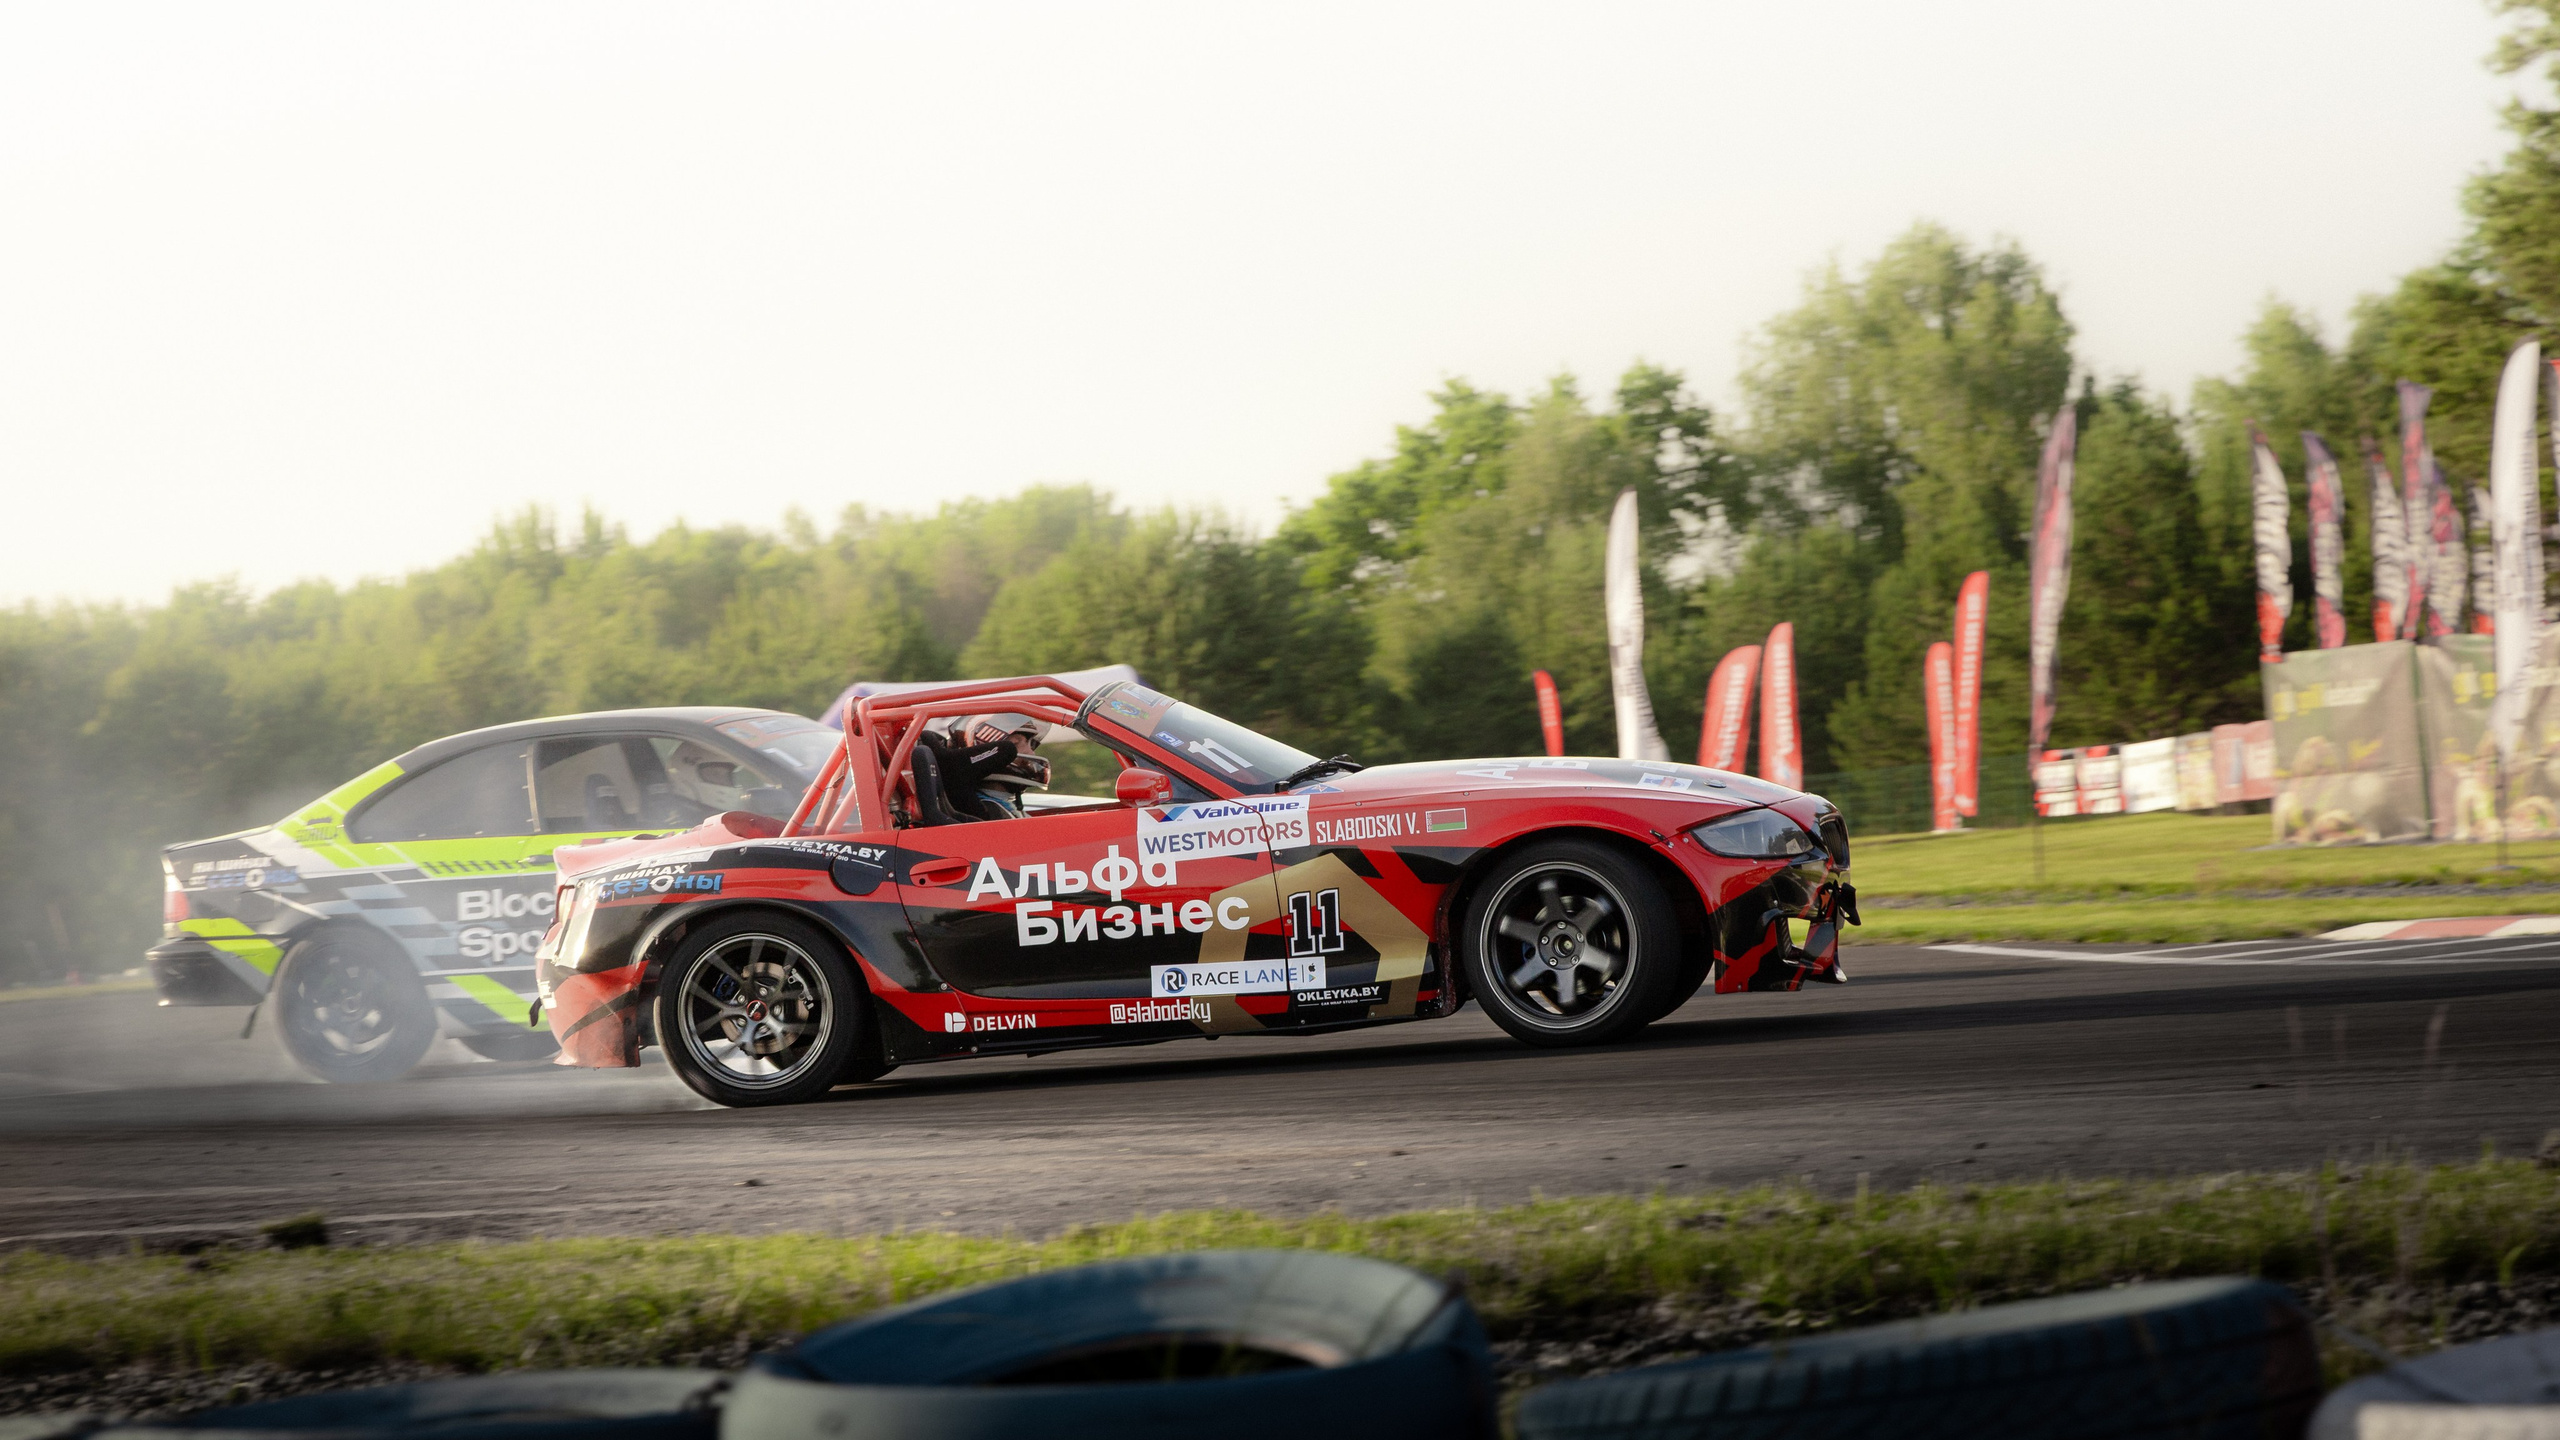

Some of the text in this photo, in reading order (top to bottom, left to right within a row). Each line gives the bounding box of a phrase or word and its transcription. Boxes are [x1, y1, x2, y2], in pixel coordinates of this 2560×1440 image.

[1188, 738, 1253, 774] 11
[1193, 802, 1300, 819] Valvoline
[1144, 820, 1303, 854] WESTMOTORS
[1316, 812, 1420, 844] SLABODSKI V.
[611, 864, 688, 882] ШИНАХ
[967, 845, 1178, 902] Альфа
[457, 888, 556, 921] Bloc
[1015, 897, 1250, 947] Бизнес
[1288, 888, 1344, 957] 11
[459, 926, 546, 962] Spo
[1191, 971, 1239, 986] RACE
[1244, 967, 1298, 984] LANE
[1296, 986, 1380, 1002] OKLEYKA.BY
[1110, 999, 1211, 1024] @slabodsky
